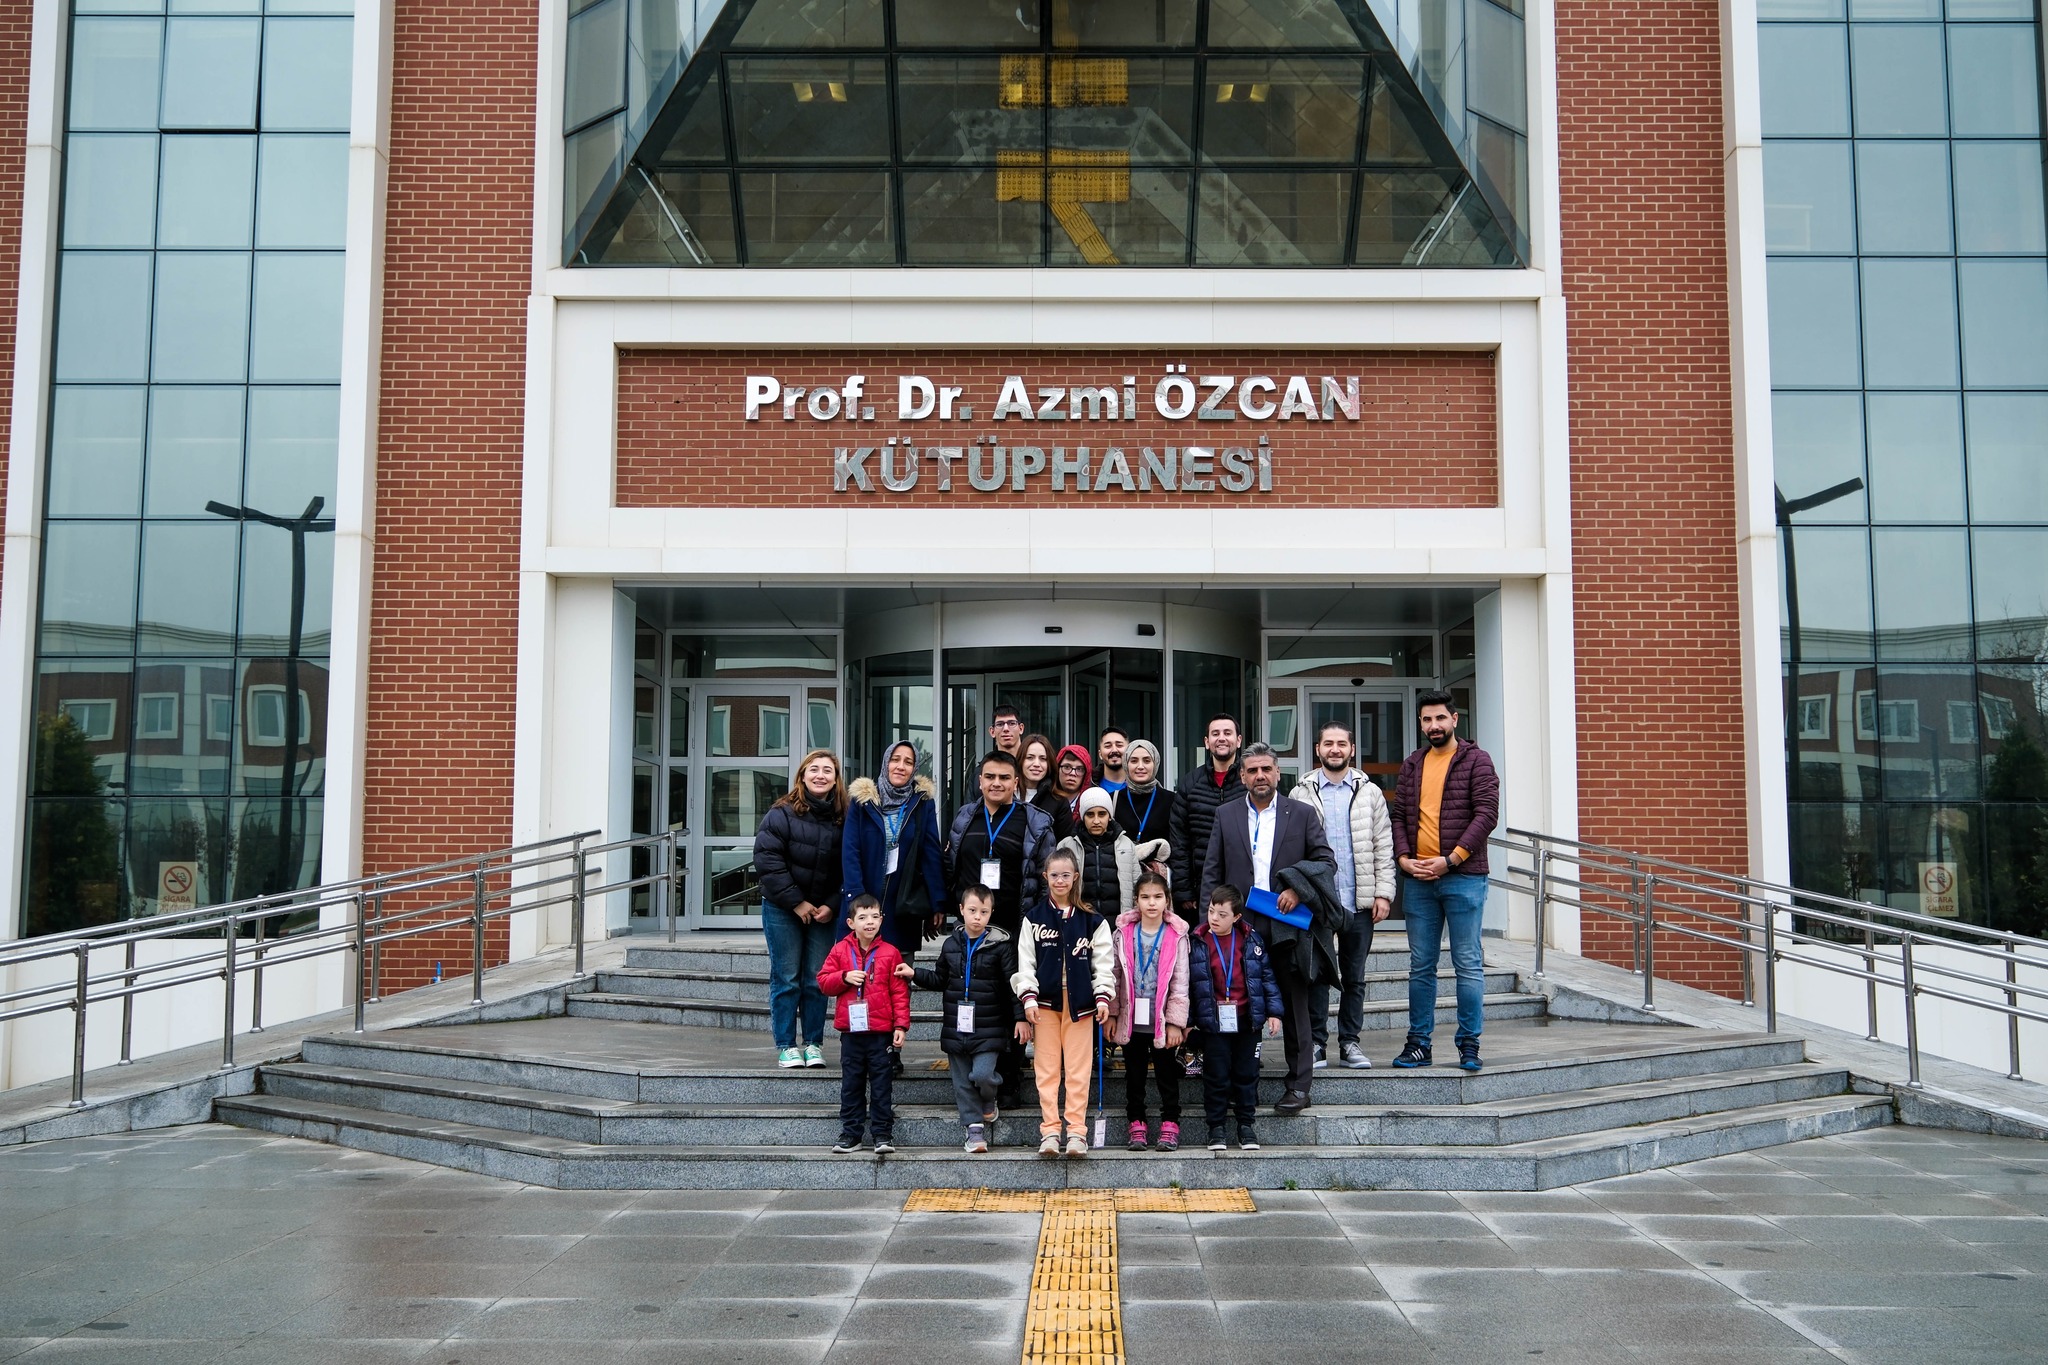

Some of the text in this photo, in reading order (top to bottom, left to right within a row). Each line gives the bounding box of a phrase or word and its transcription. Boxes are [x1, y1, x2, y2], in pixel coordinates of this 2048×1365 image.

[746, 364, 1360, 421] Prof. Dr. Azmi ÖZCAN
[834, 435, 1273, 492] KÜTÜPHANESİ
[1031, 923, 1059, 941] New
